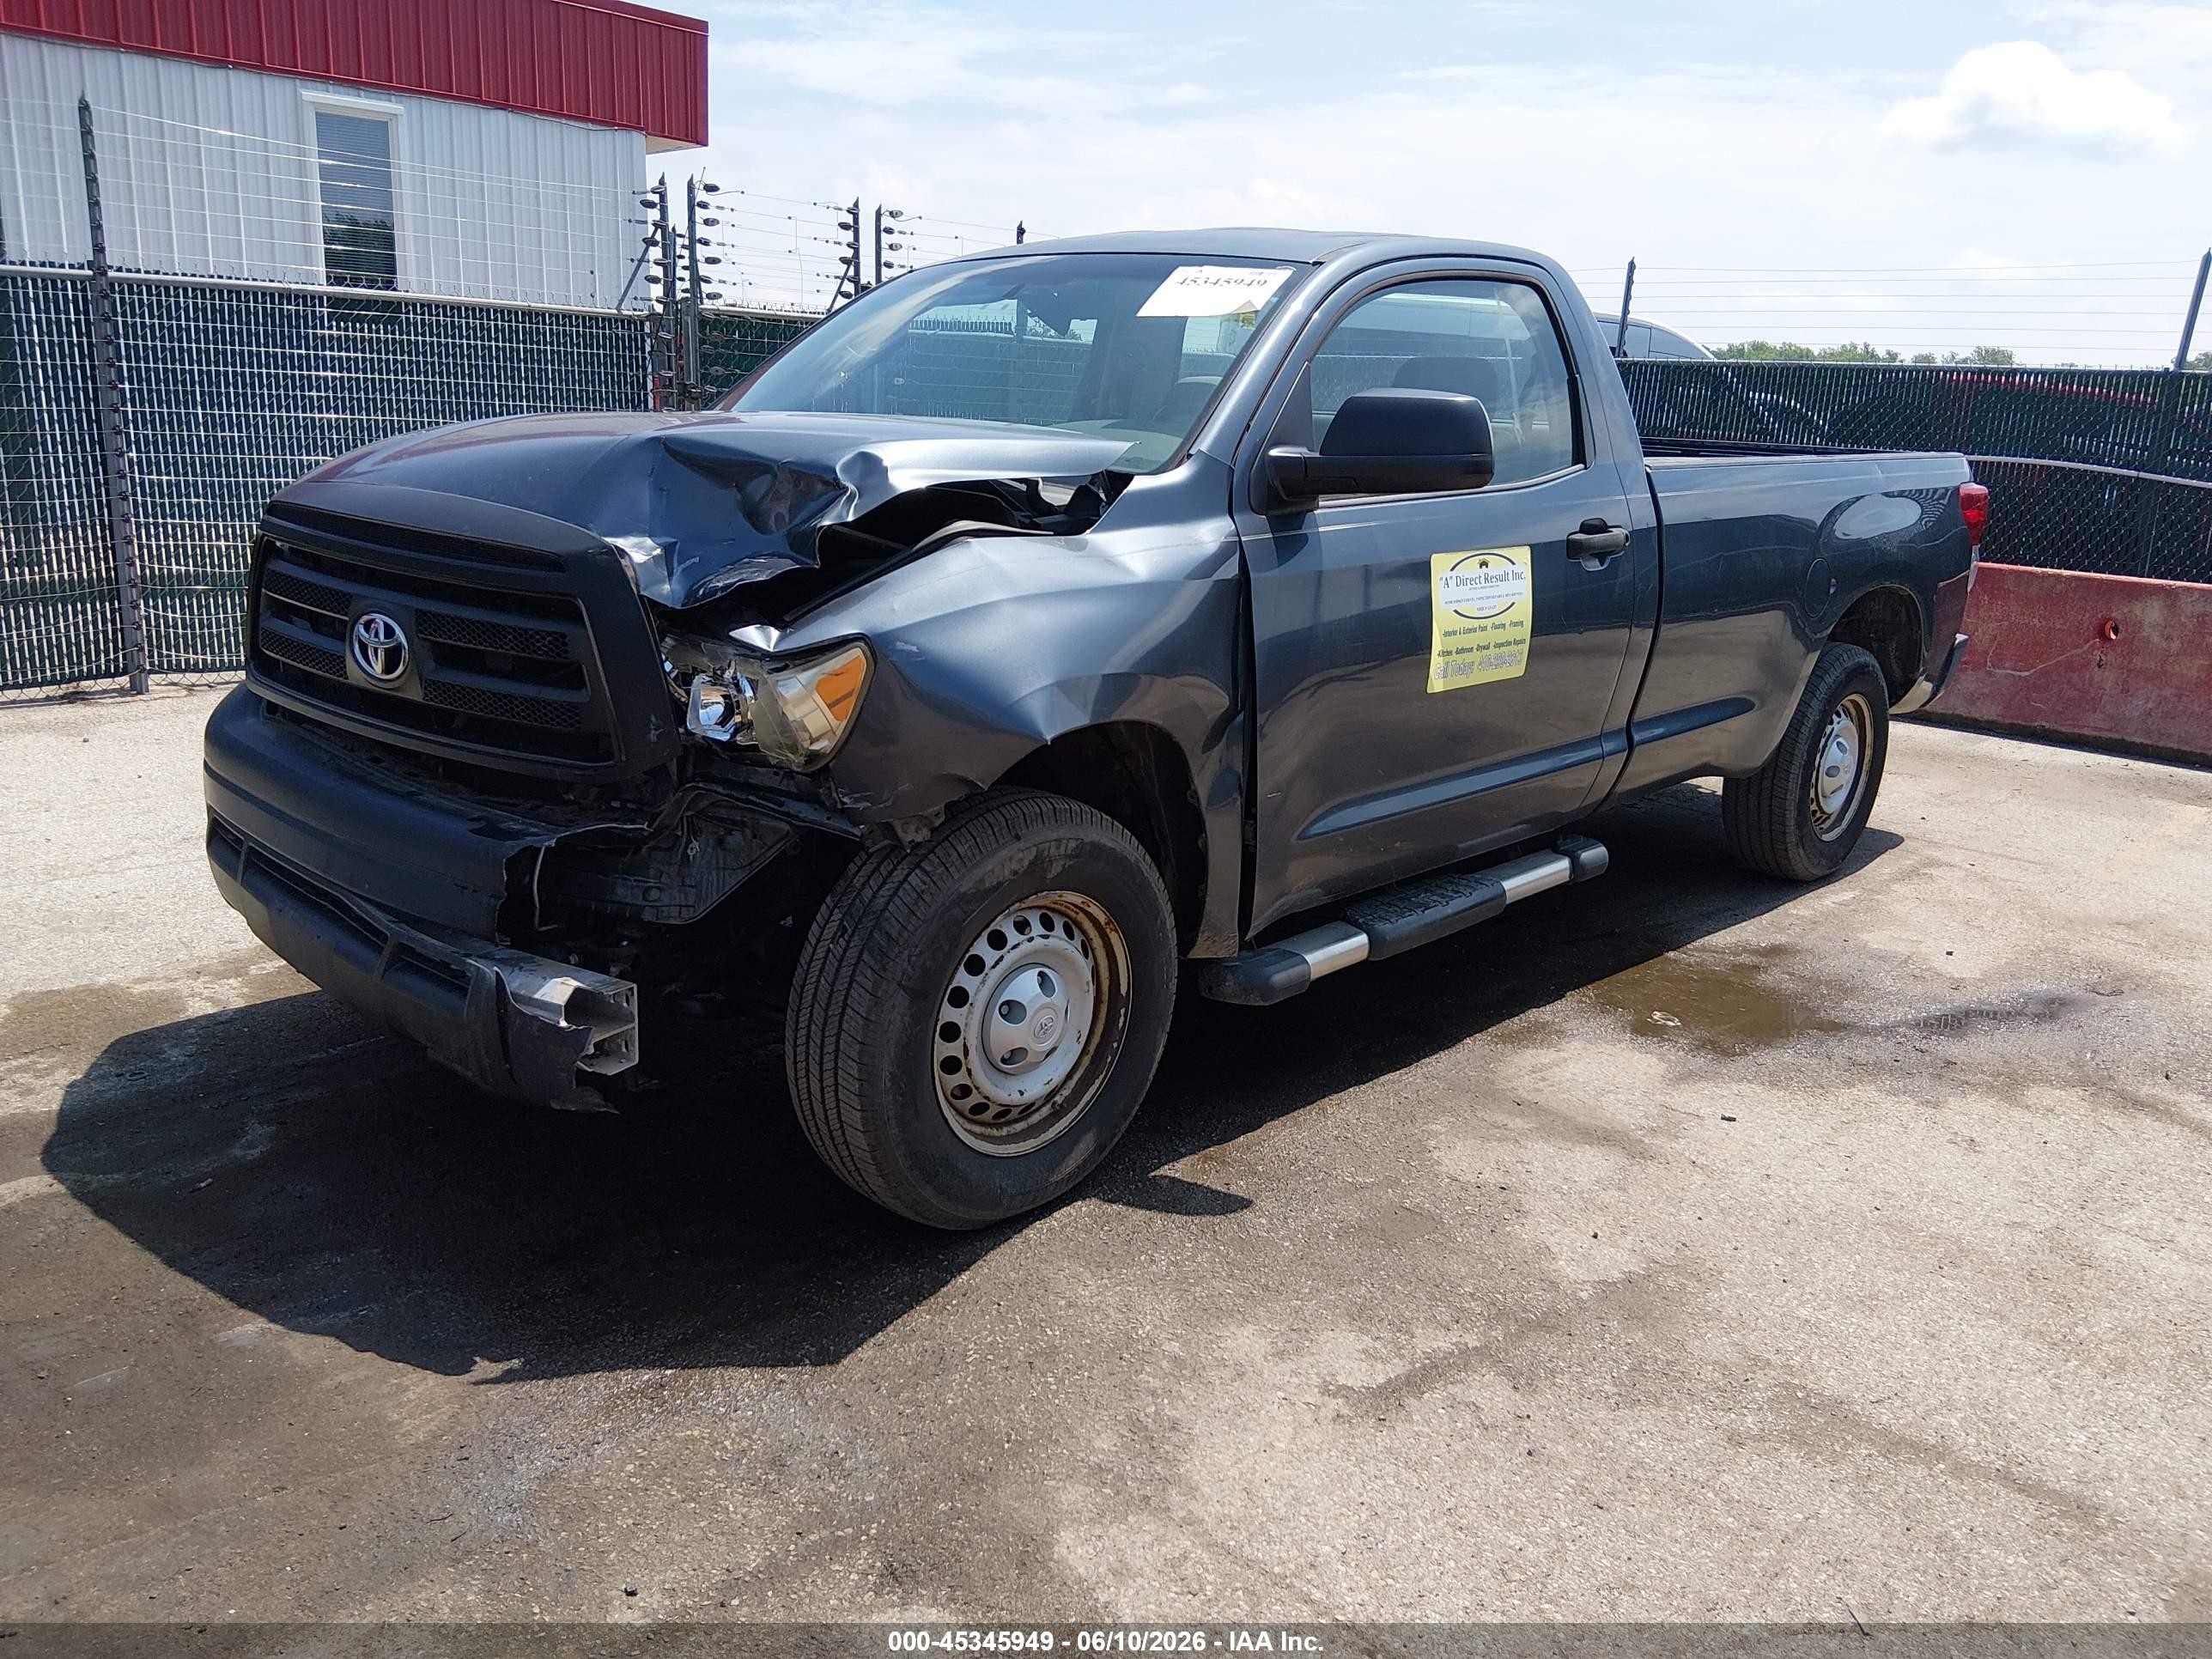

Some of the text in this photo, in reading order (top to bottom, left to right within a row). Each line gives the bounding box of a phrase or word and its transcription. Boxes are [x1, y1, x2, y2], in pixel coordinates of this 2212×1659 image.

[1176, 276, 1268, 288] 45345949
[1439, 575, 1453, 589] "A"
[1455, 574, 1483, 587] Direct
[1484, 570, 1510, 585] Result
[1511, 569, 1526, 581] Inc.
[1434, 660, 1449, 679] Call
